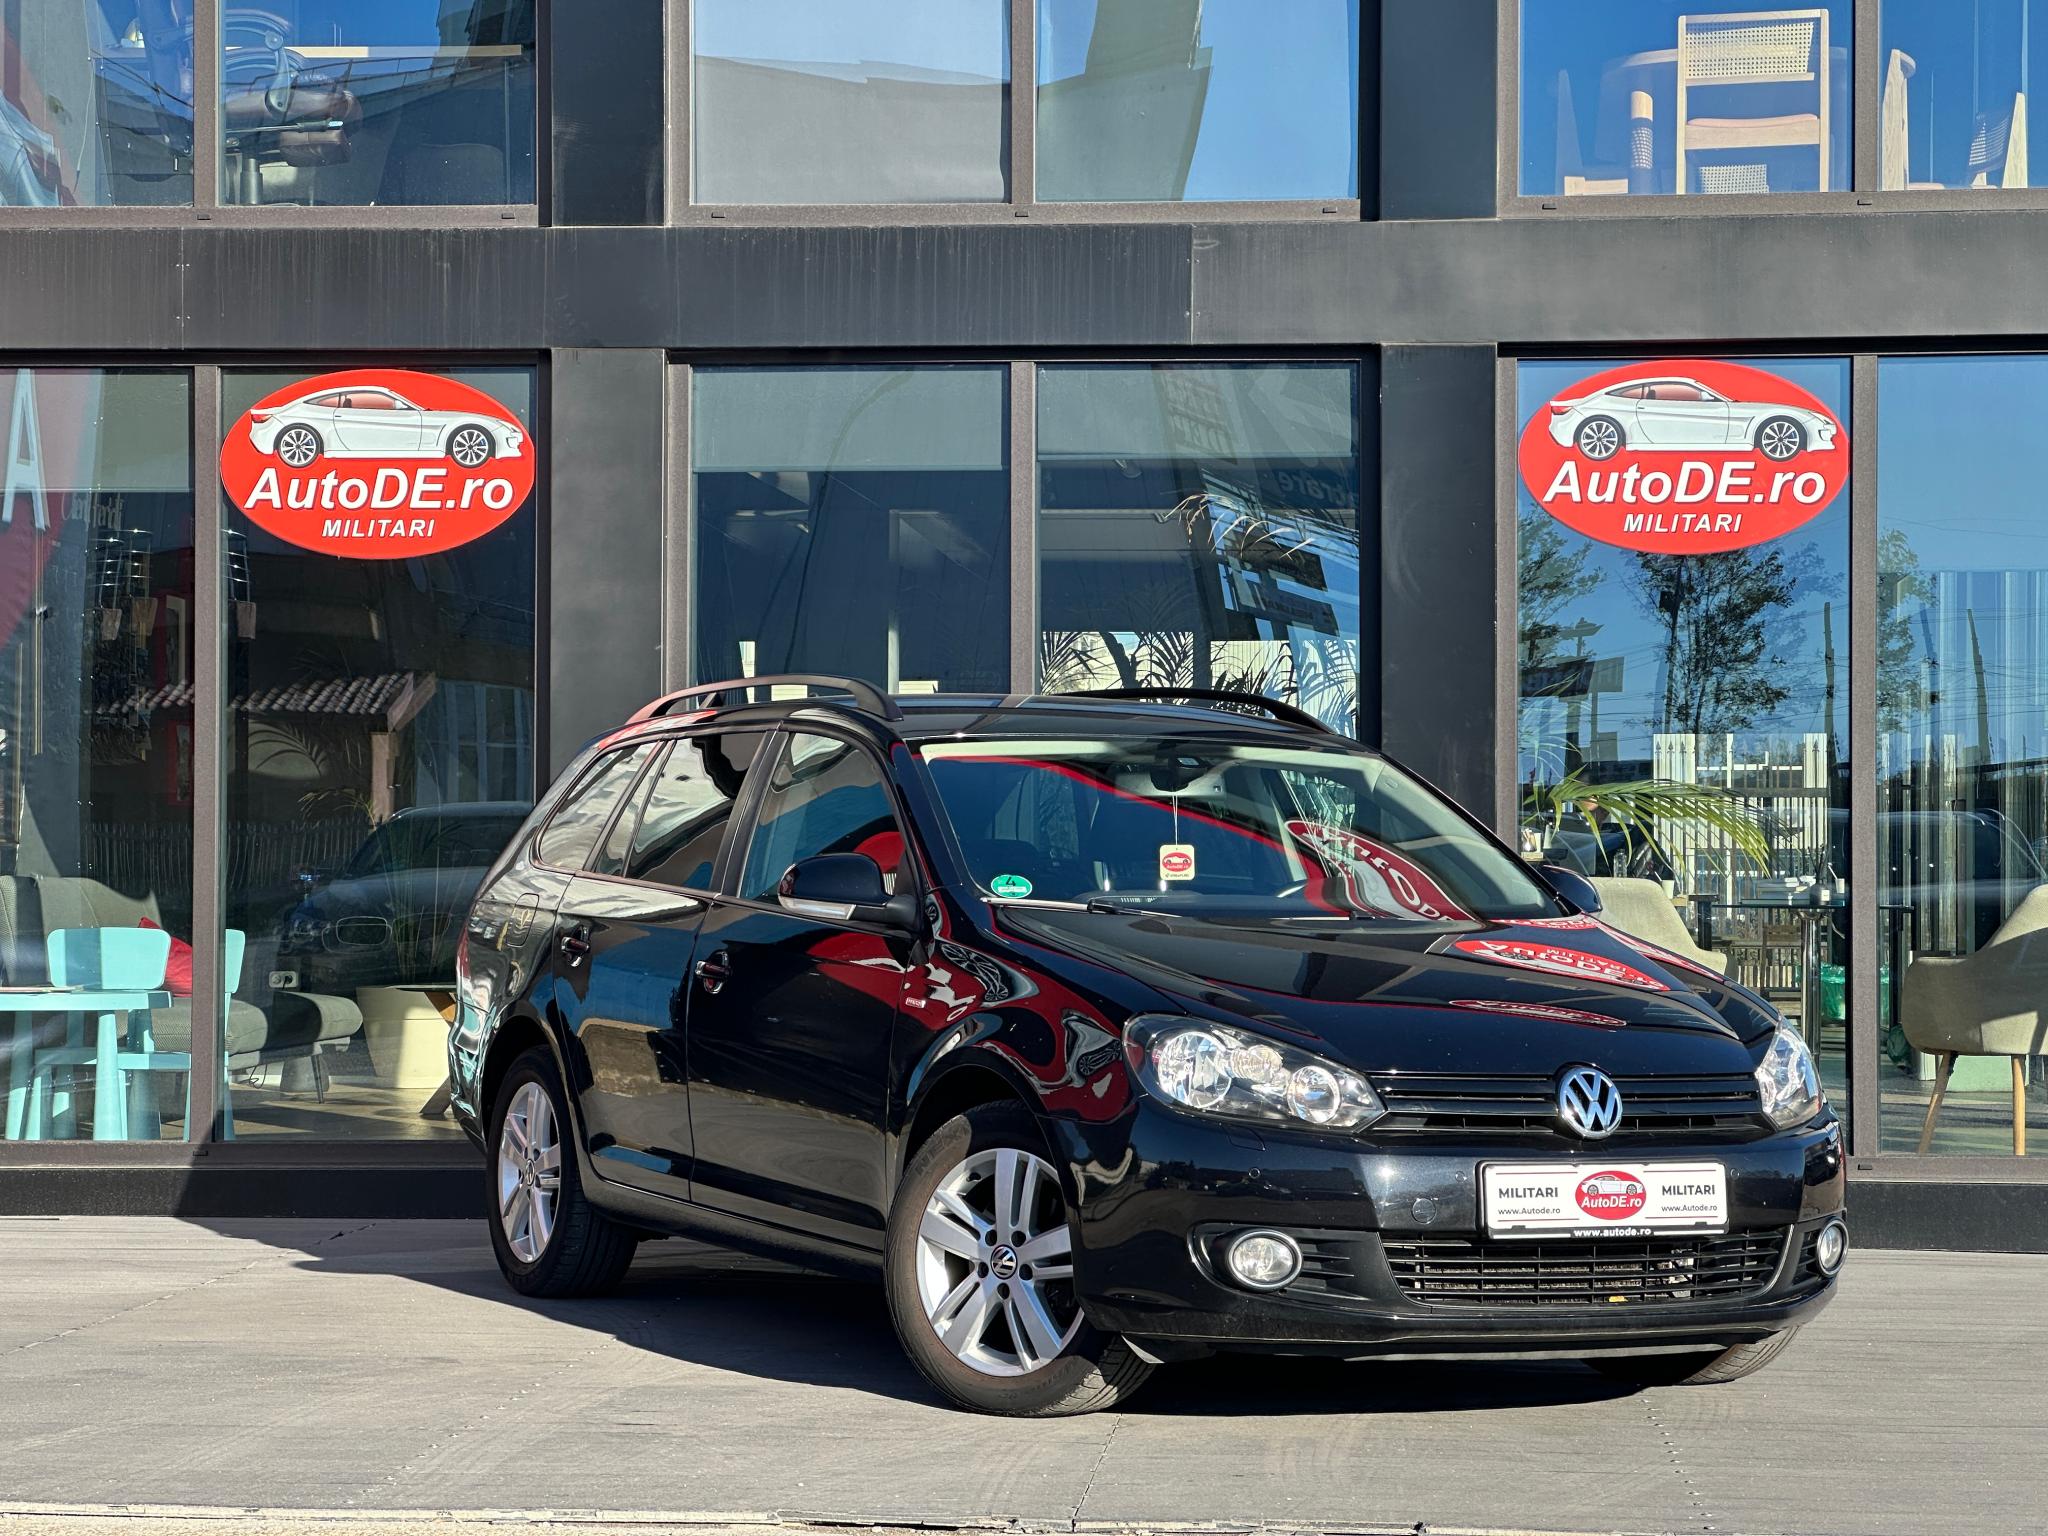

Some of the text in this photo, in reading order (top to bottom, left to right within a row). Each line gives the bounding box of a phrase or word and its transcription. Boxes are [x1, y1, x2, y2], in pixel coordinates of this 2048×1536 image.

[244, 467, 514, 510] AutoDE.ro
[1543, 460, 1827, 504] AutoDE.ro
[322, 519, 435, 538] MILITARI
[1623, 513, 1742, 533] MILITARI
[1005, 876, 1017, 887] 4
[1498, 1186, 1559, 1199] MILITARI
[1661, 1184, 1716, 1196] MILITARI
[1581, 1195, 1642, 1208] AutoDE.ro
[1498, 1206, 1561, 1216] www.Autode.ro
[1661, 1204, 1718, 1213] www.Autode.ro
[1573, 1228, 1652, 1238] www.autode.ro
